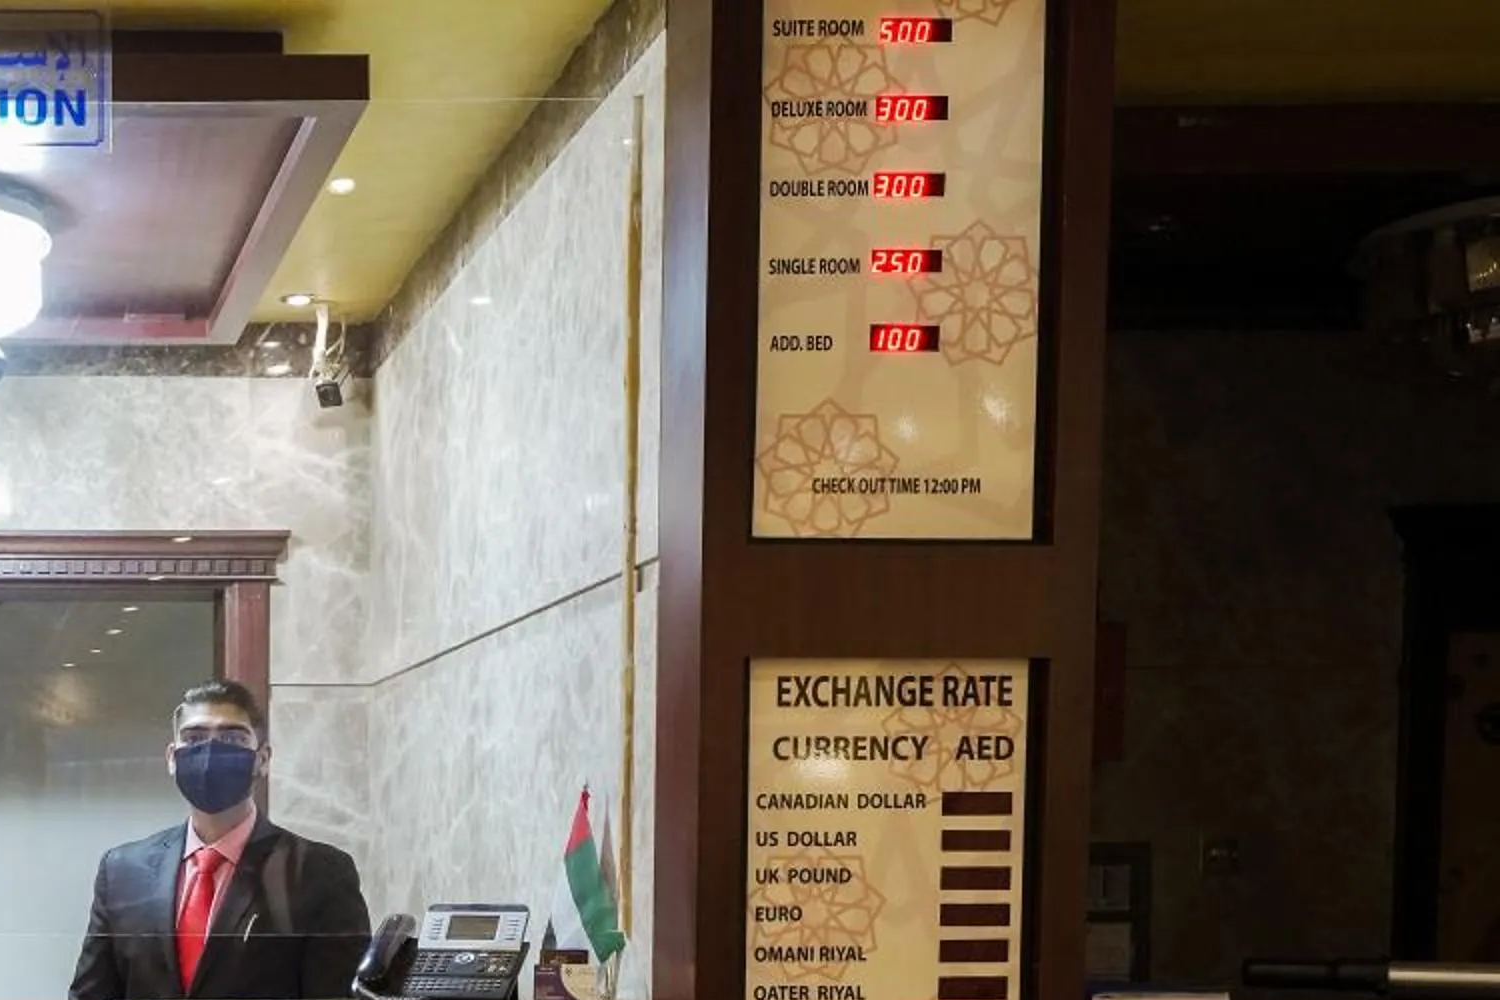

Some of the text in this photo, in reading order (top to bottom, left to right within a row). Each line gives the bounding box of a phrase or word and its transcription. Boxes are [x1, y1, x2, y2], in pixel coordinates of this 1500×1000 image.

[772, 19, 931, 43] SUITE ROOM 500
[771, 99, 928, 121] DELUXE ROOM 300
[769, 175, 925, 197] DOUBLE ROOM 300
[769, 252, 922, 275] SINGLE ROOM 250
[770, 329, 921, 352] ADD. BED 100
[812, 478, 981, 495] CHECK OUT TIME 12:00 PM
[777, 675, 1013, 707] EXCHANGE RATE
[772, 735, 1015, 761] CURRENCY AED
[756, 793, 927, 809] CANADIAN DOLLAR
[756, 831, 857, 847] US DOLLAR
[755, 868, 852, 884] UK POUND
[755, 906, 803, 922] EURO
[754, 946, 867, 962] OMANI RIYAL
[817, 985, 866, 1000] RIYAL
